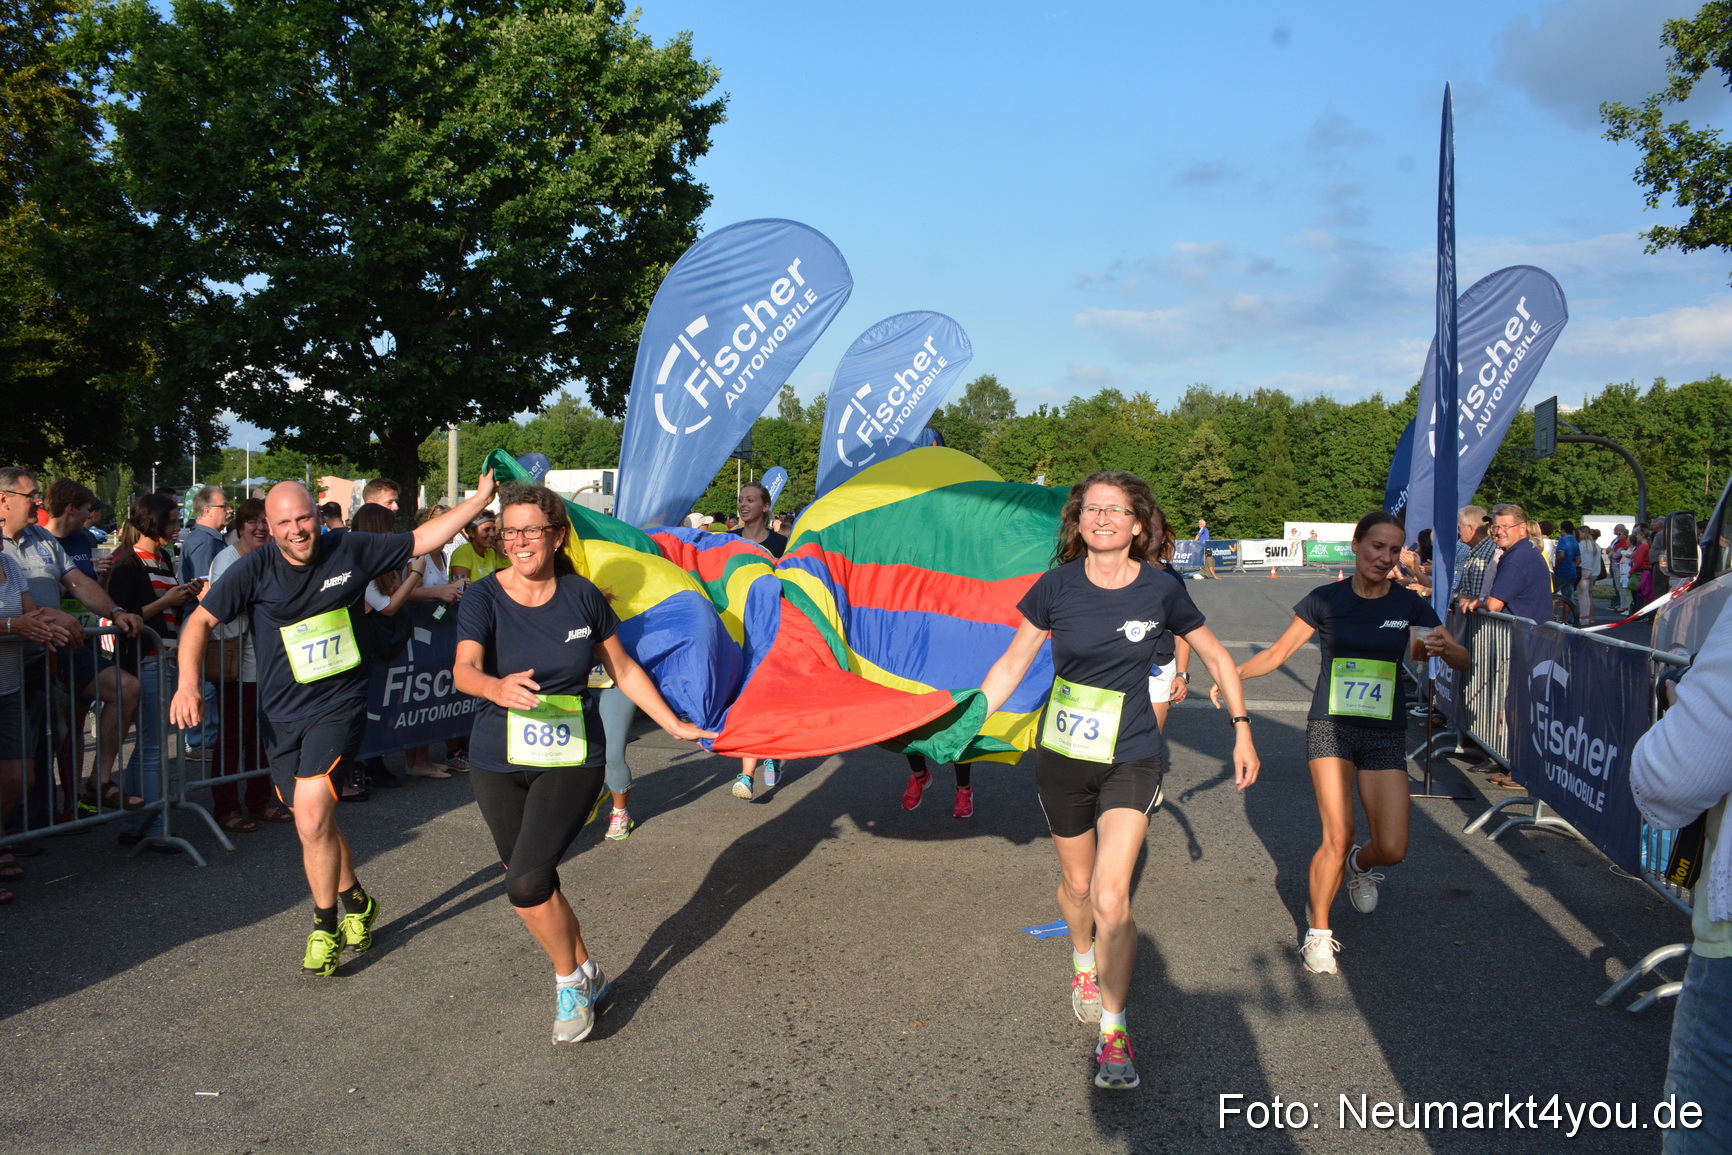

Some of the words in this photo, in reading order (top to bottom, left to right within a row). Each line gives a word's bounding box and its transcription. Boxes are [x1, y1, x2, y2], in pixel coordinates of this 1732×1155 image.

[684, 257, 805, 409] Fischer
[724, 288, 818, 409] AUTOMOBILE
[856, 335, 938, 448] Fischer
[884, 356, 948, 446] AUTOMOBILE
[1475, 320, 1541, 437] AUTOMOBILE
[1309, 544, 1329, 555] AOK
[302, 635, 341, 664] 777
[1056, 709, 1100, 741] 673
[1343, 681, 1382, 702] 774
[523, 723, 571, 747] 689
[1536, 701, 1618, 781] Fischer
